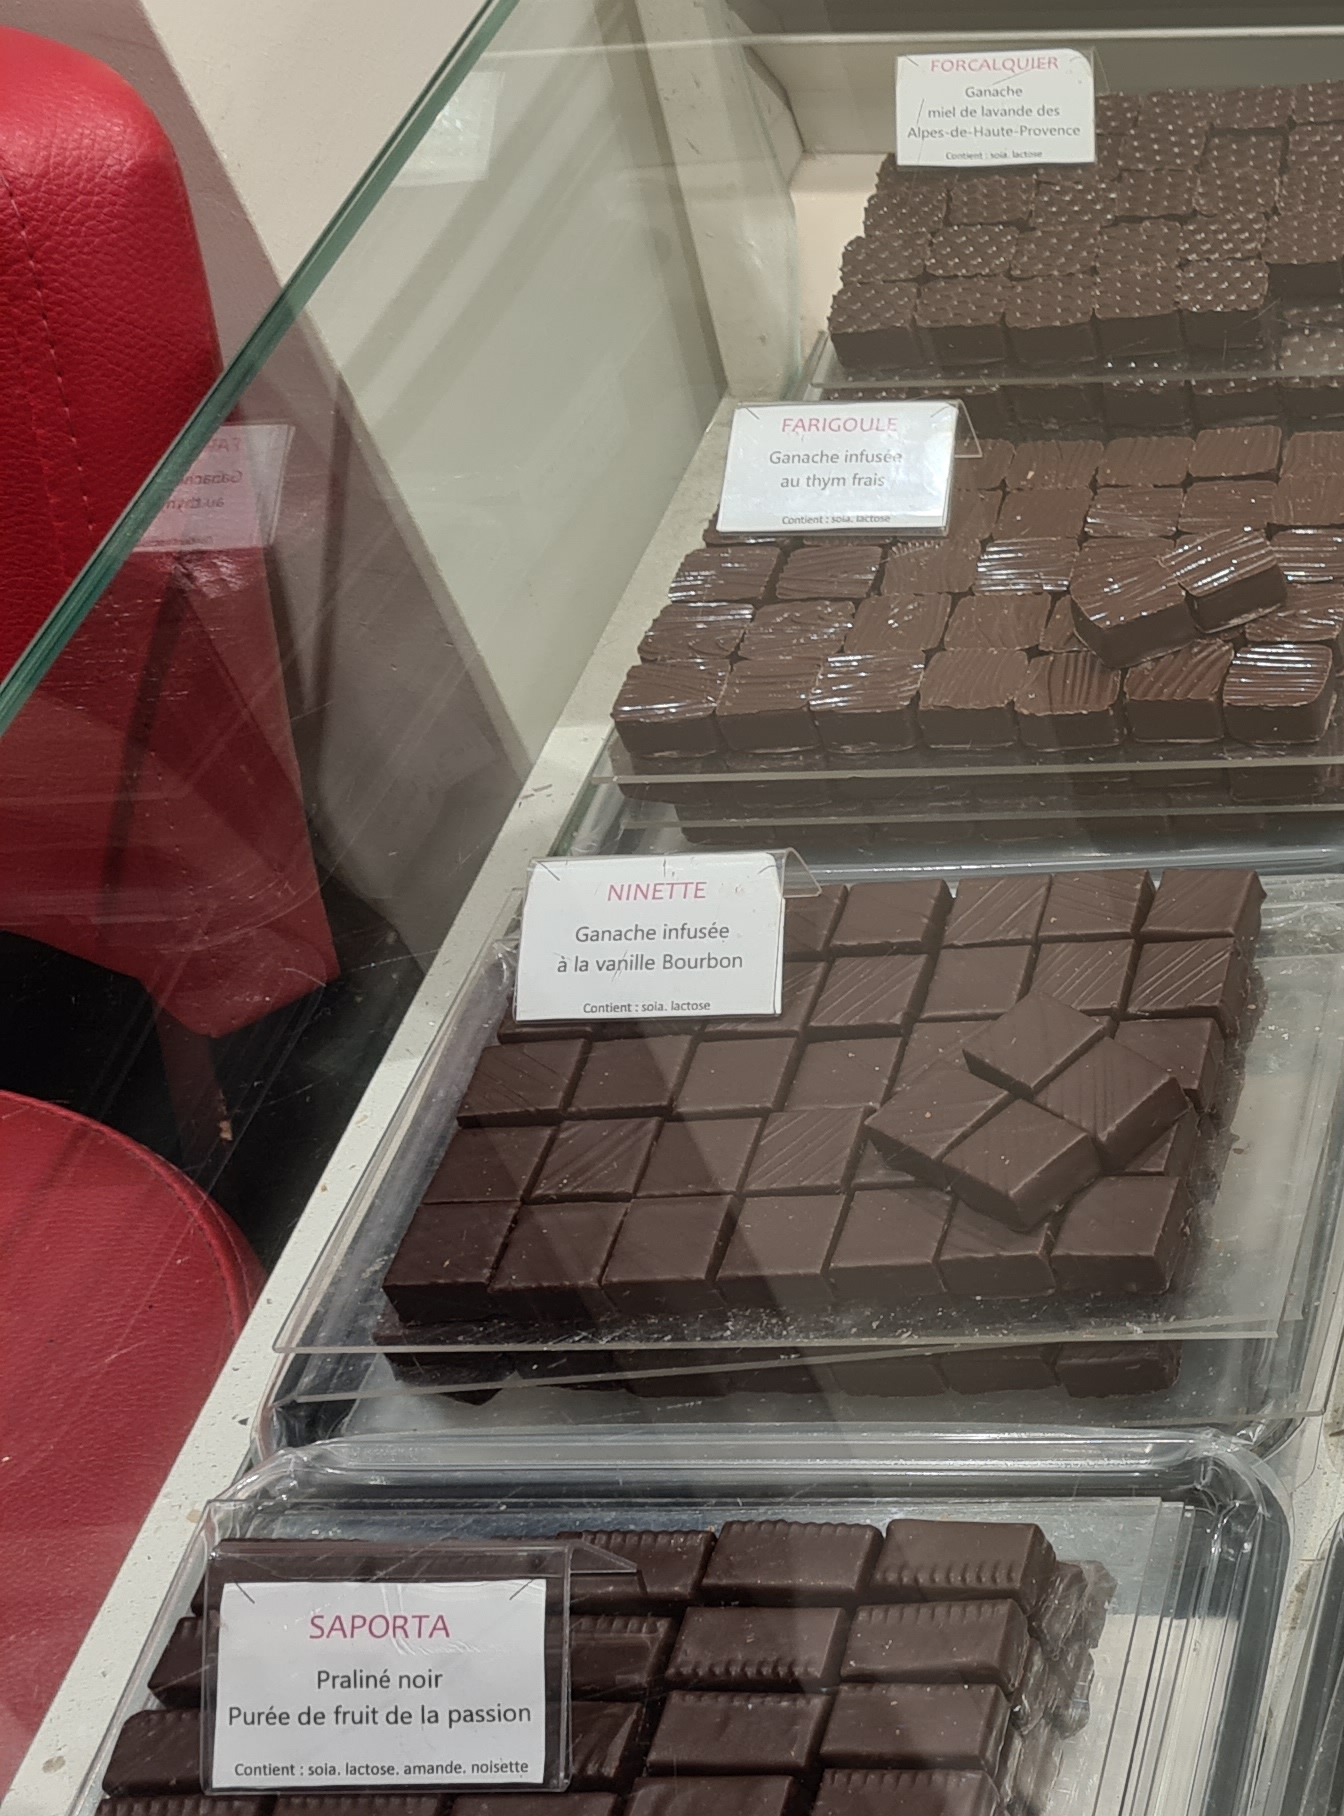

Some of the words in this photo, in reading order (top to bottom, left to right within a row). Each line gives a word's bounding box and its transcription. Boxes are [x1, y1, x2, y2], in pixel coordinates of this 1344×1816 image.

[931, 57, 1059, 74] FORCALQUIER
[965, 86, 1023, 98] Ganache
[928, 107, 955, 118] miel
[960, 106, 977, 117] de
[982, 106, 1033, 117] lavande
[1037, 105, 1060, 115] des
[907, 126, 1080, 139] Alpes-de-Haute-Provence
[782, 418, 898, 432] FARIGOULE
[770, 451, 839, 464] Ganache
[845, 449, 902, 463] infusée
[781, 477, 799, 488] au
[806, 474, 845, 490] thym
[852, 473, 885, 487] frais
[782, 516, 823, 524] Contient
[607, 882, 707, 901] NINETTE
[575, 924, 656, 942] Ganache
[663, 922, 729, 940] infusée
[557, 956, 567, 973] à
[575, 956, 589, 972] la
[596, 954, 655, 971] vanille
[662, 952, 743, 970] Bourbon
[583, 1002, 632, 1014] Contient
[671, 1000, 711, 1011] lactose
[309, 1615, 451, 1639] SAPORTA
[317, 1669, 391, 1690] Praliné
[398, 1669, 444, 1688] noir
[229, 1706, 290, 1726] Purée
[297, 1706, 326, 1725] de
[334, 1705, 378, 1725] fruit
[385, 1704, 413, 1725] de
[421, 1704, 439, 1724] la
[448, 1703, 531, 1728] passion
[235, 1764, 296, 1777] Contient
[471, 1759, 529, 1774] noisette
